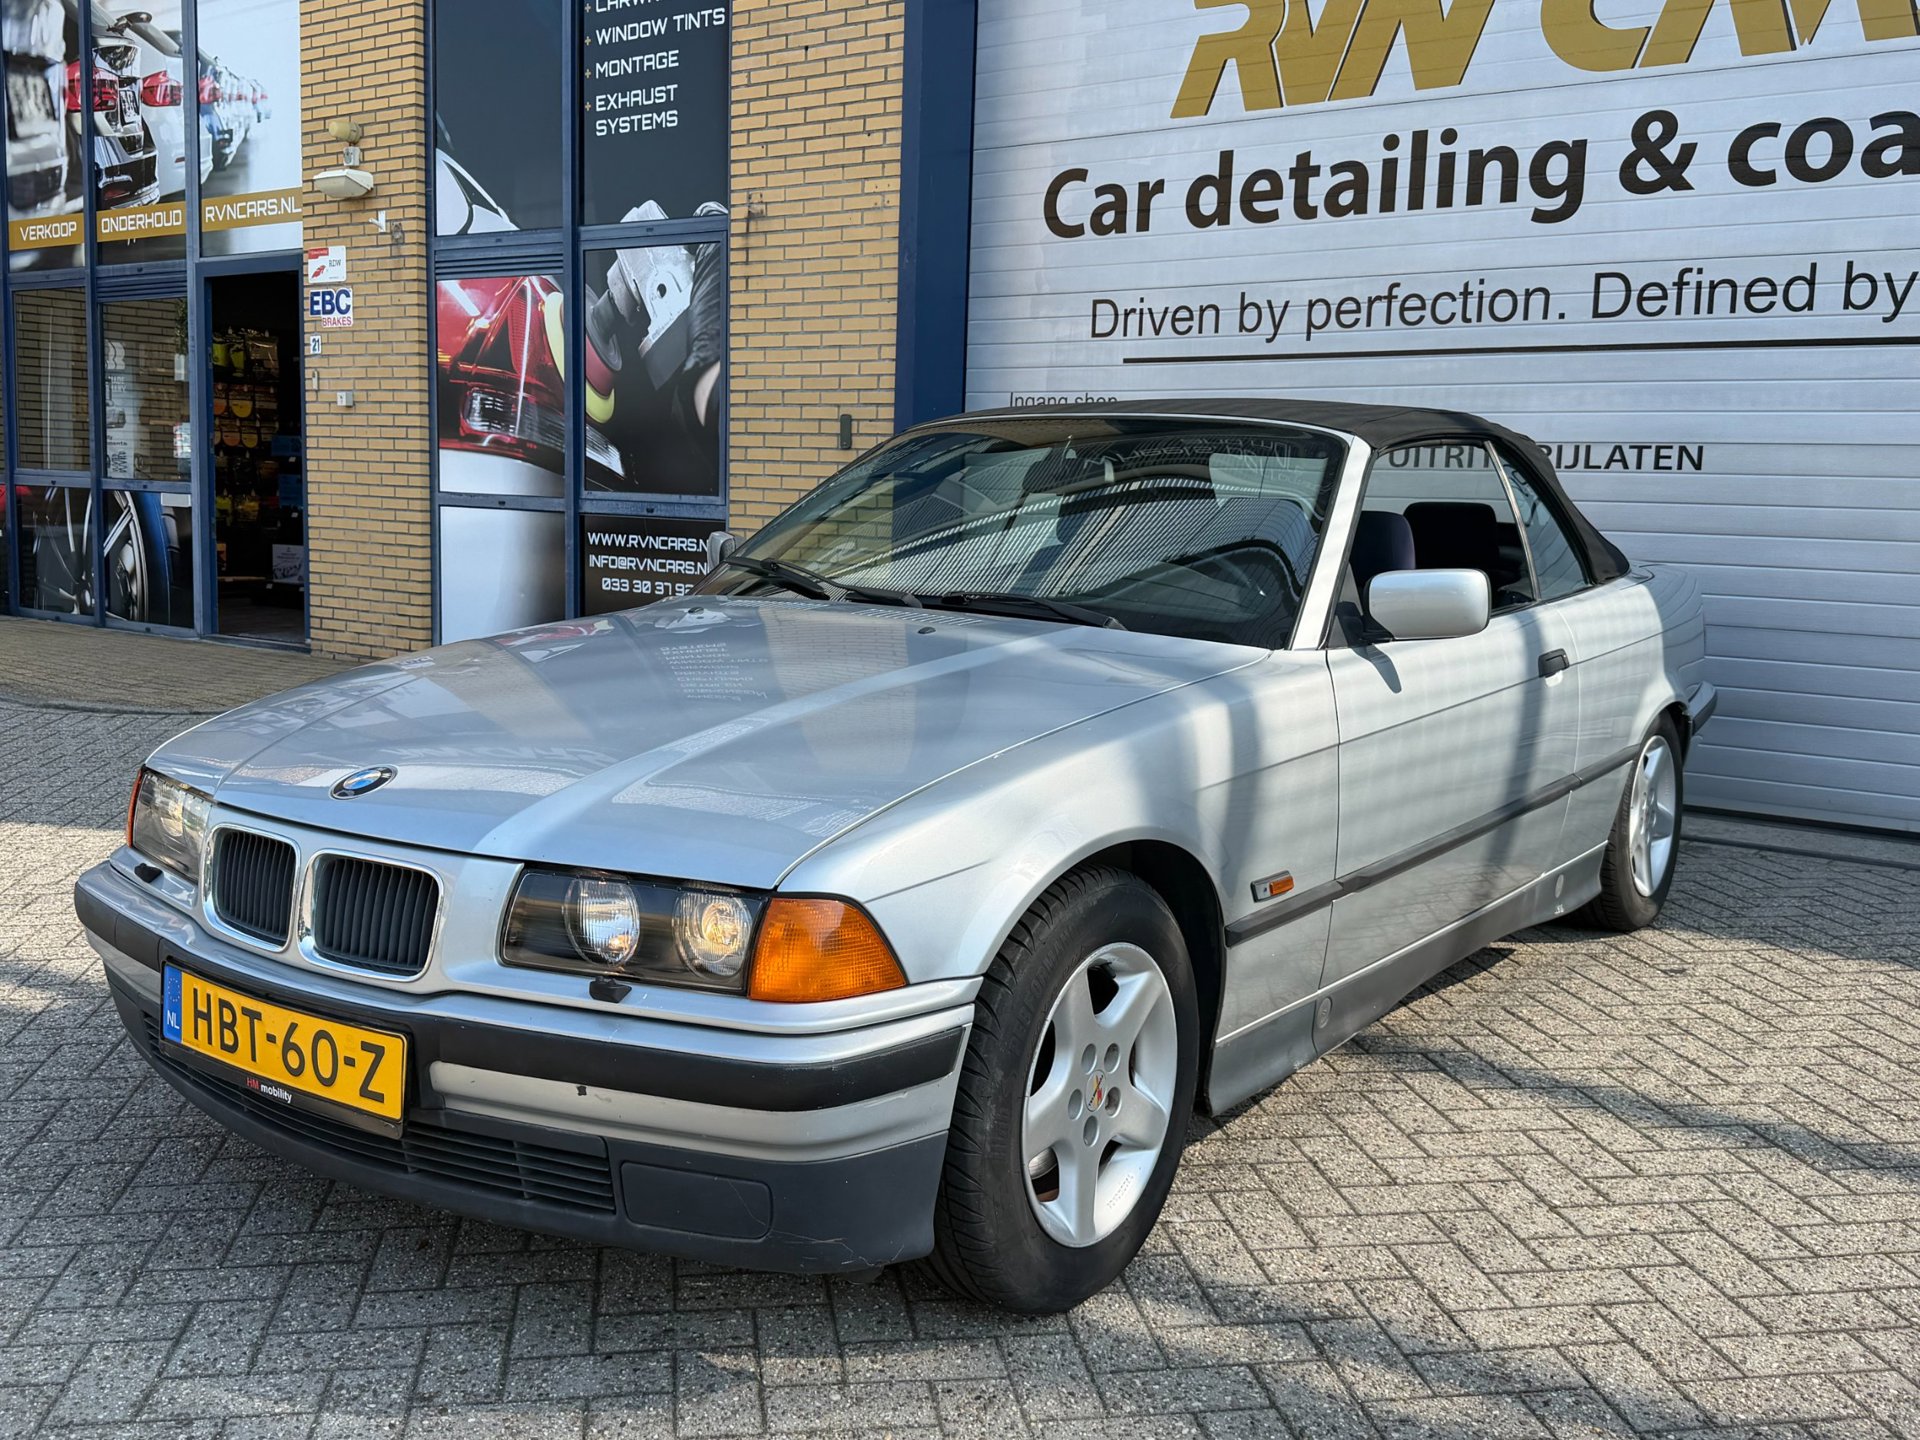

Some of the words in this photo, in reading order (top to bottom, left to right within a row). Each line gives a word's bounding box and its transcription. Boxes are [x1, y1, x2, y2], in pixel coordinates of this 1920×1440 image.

[596, 17, 668, 45] WINDOW
[673, 7, 725, 32] TINTS
[595, 50, 679, 79] MONTAGE
[1170, 0, 1496, 118] RVN
[595, 84, 678, 111] EXHAUST
[595, 110, 678, 136] SYSTEMS
[1043, 168, 1165, 238] Car
[1185, 127, 1588, 229] detailing
[1619, 110, 1698, 195] &
[1728, 110, 1920, 187] coa
[101, 209, 182, 233] ONDERHOUD
[205, 196, 302, 222] RVNCARS.NL
[19, 221, 77, 241] VERKOOP
[310, 289, 351, 316] EBC
[1091, 297, 1220, 339] Driven
[1239, 292, 1290, 343] by
[1306, 278, 1565, 342] perfection.
[1591, 262, 1817, 319] Defined
[1842, 260, 1920, 323] by
[322, 316, 352, 326] BRAKES
[312, 338, 320, 352] 21
[587, 532, 708, 552] WWW.RVNCARS.N
[602, 577, 629, 592] 033
[632, 580, 651, 594] 30
[655, 582, 672, 596] 37
[166, 1011, 180, 1030] NL
[193, 987, 386, 1104] HBT-60-Z
[246, 1077, 259, 1090] HM
[260, 1084, 292, 1104] mobility
